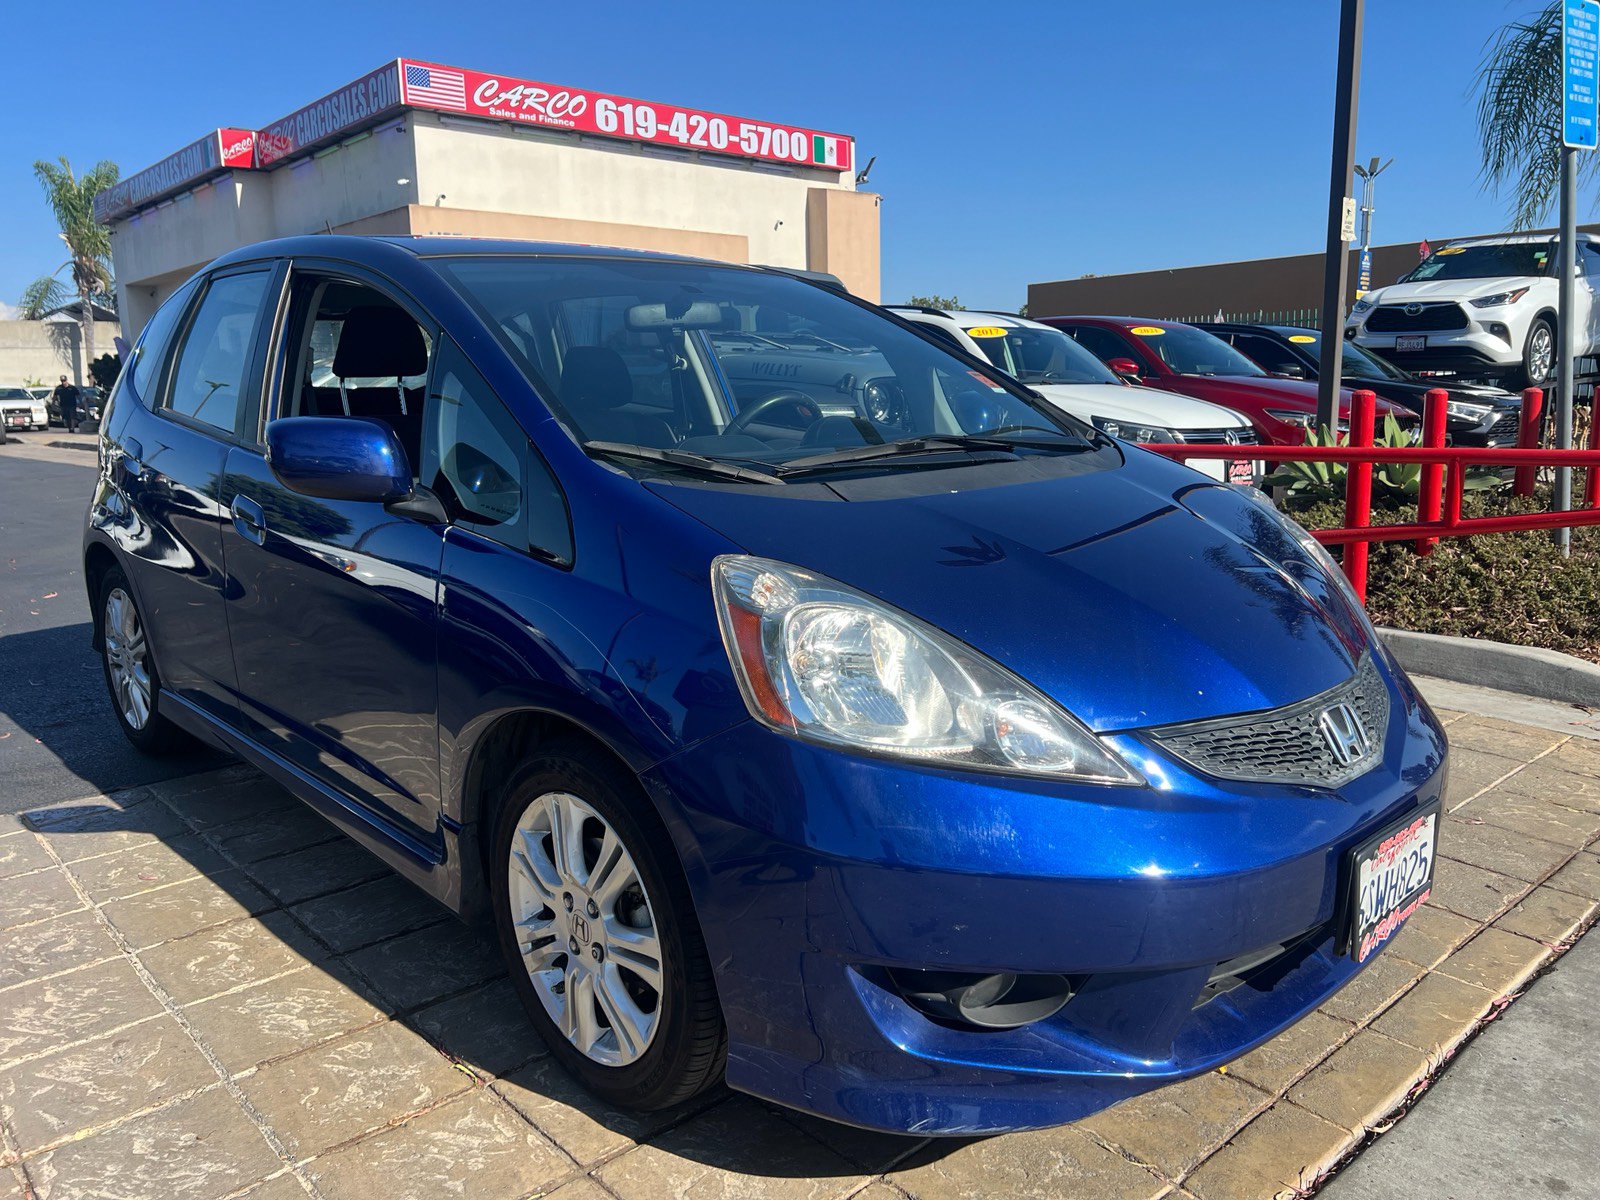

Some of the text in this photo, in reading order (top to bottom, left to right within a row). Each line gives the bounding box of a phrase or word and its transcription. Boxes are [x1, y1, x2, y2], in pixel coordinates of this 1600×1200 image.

[296, 66, 399, 147] CARCOSALES.COM
[473, 79, 808, 161] CARCO 619-420-5700
[489, 107, 575, 127] Sales and Finance
[223, 137, 253, 159] CARCO
[129, 149, 202, 203] CARCOSALES.COM
[976, 328, 999, 336] 2017
